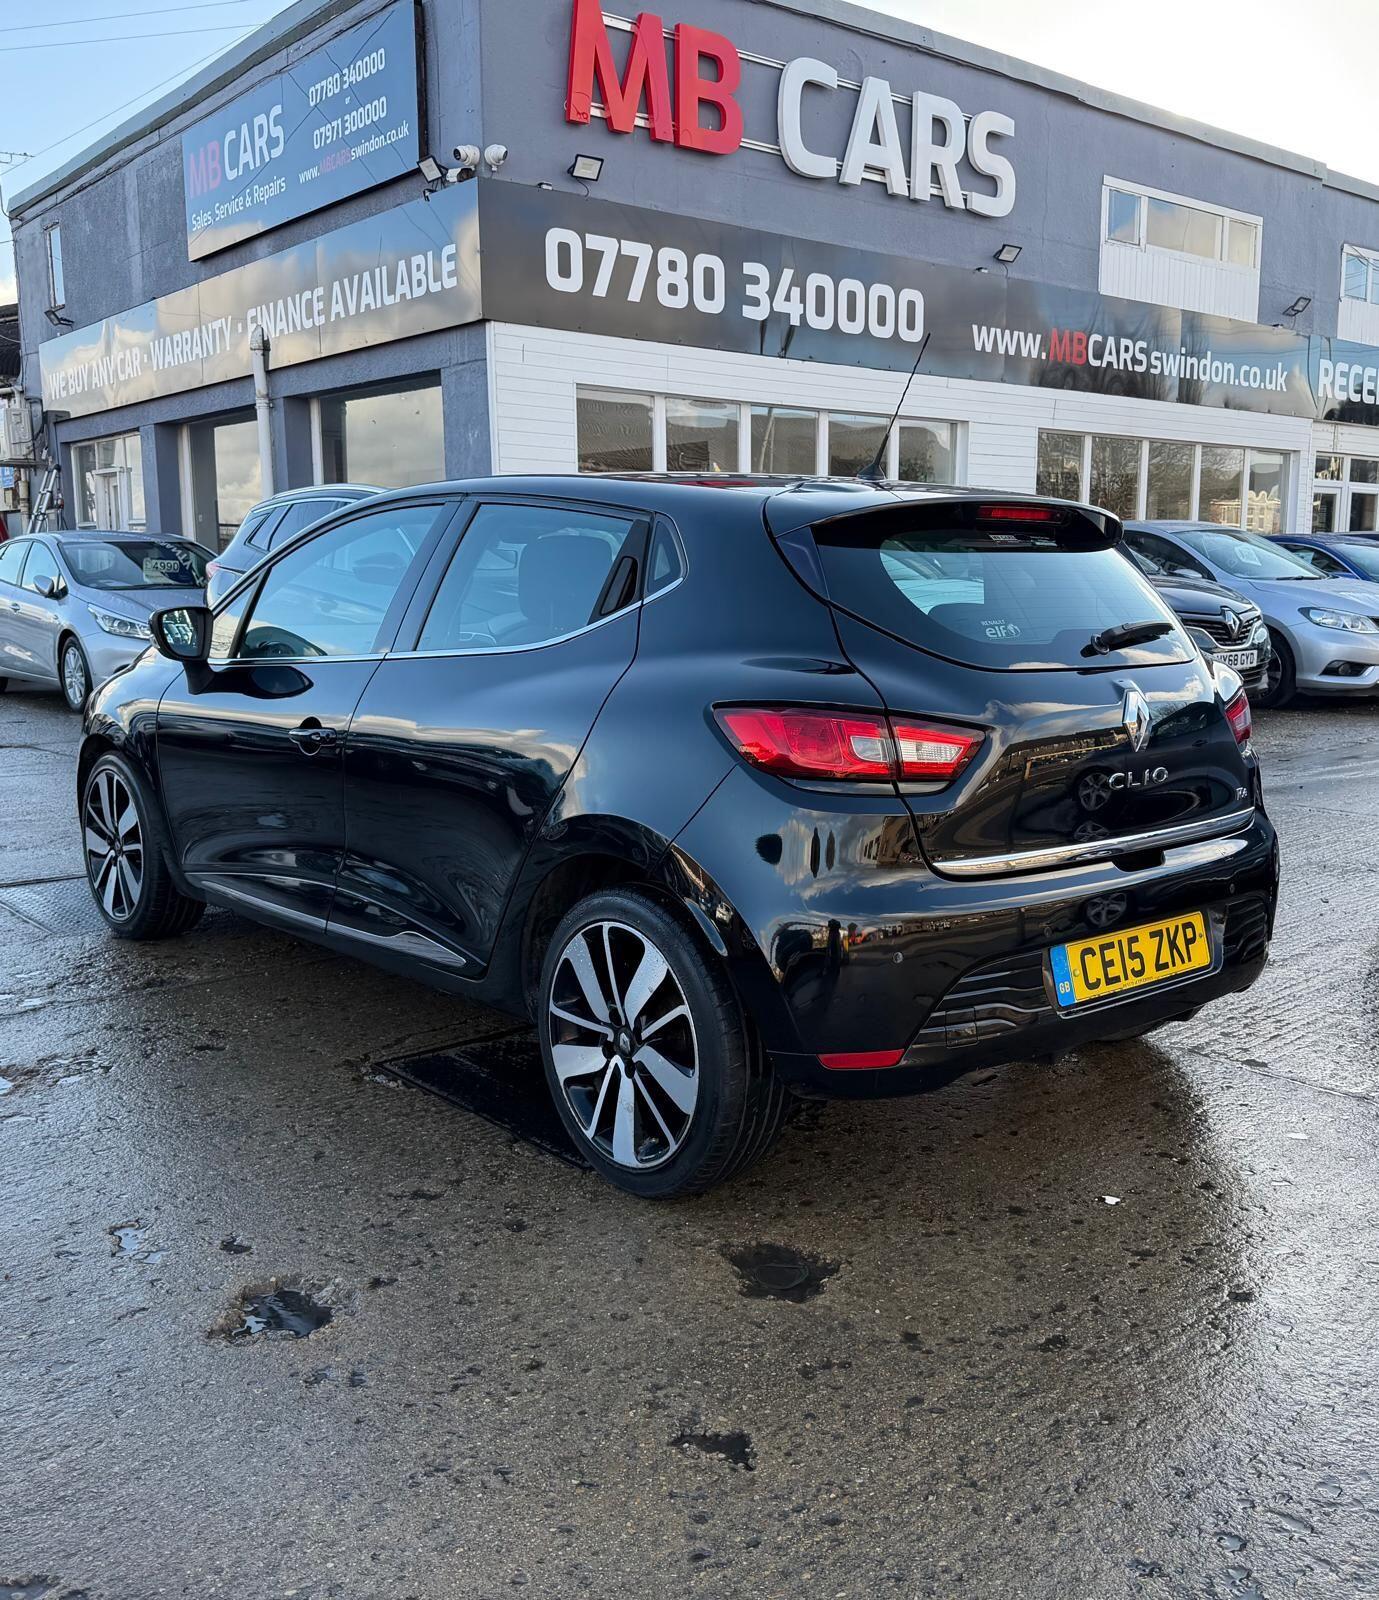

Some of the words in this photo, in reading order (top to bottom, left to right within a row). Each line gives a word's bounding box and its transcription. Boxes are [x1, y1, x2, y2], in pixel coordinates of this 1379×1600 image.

[309, 73, 341, 107] 07780
[342, 47, 386, 90] 340000
[313, 119, 343, 150] 07971
[344, 96, 387, 136] 300000
[565, 0, 744, 155] MB
[777, 57, 1016, 218] CARS
[191, 207, 214, 232] Sales,
[214, 196, 244, 222] Service
[245, 191, 252, 207] &
[253, 176, 286, 205] Repairs
[545, 227, 726, 315] 07780
[741, 261, 925, 344] 340000
[48, 369, 67, 400] WE
[68, 363, 89, 395] BUY
[91, 353, 115, 389] ANY
[116, 347, 141, 381] CAR
[149, 315, 232, 371] WARRANTY
[246, 286, 325, 345] FINANCE
[330, 243, 458, 322] AVAILABLE
[1318, 359, 1379, 405] RECE
[1108, 766, 1168, 790] CLIO
[1080, 936, 1146, 991] CE15
[1149, 921, 1197, 972] ZKP
[1059, 981, 1071, 994] GB
